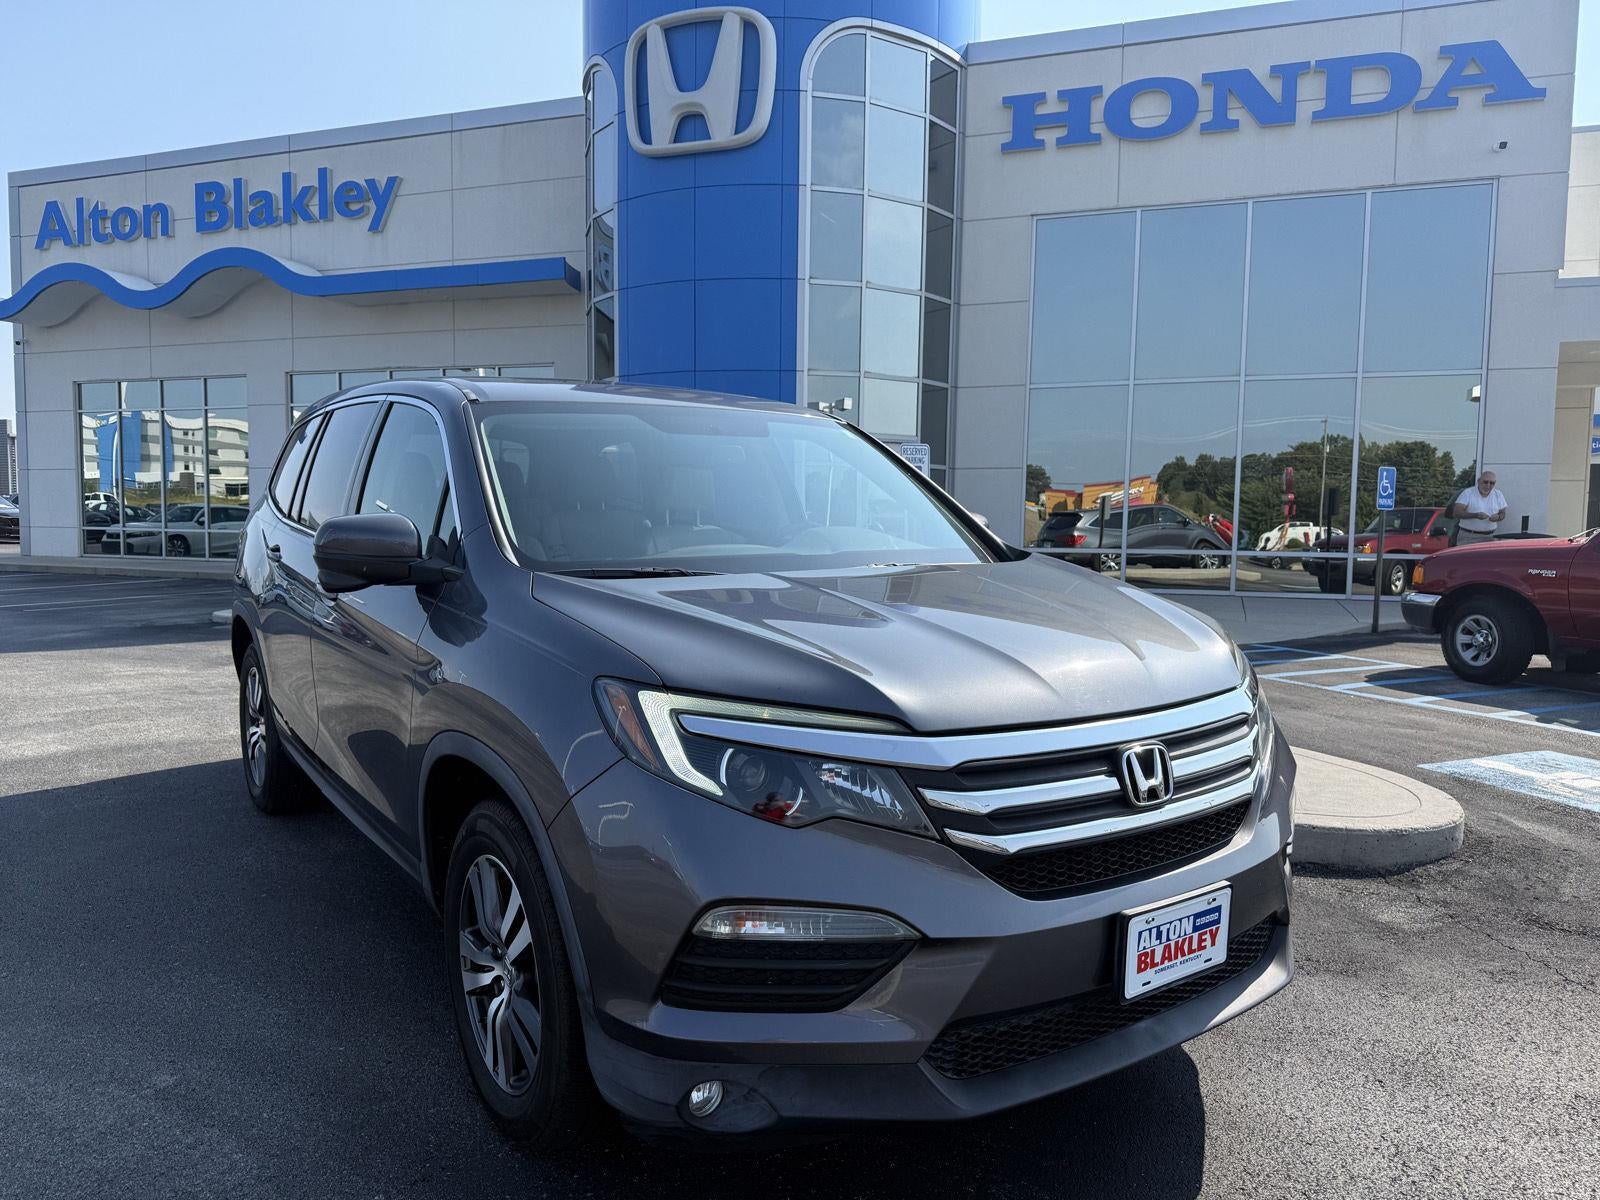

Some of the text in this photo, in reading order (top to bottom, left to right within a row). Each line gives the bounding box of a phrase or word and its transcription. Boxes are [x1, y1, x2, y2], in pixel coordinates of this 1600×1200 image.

[1001, 40, 1546, 153] HONDA
[35, 167, 402, 250] Alton Blakley
[902, 447, 927, 456] RESERVED
[1136, 926, 1221, 975] BLAKLEY
[1138, 915, 1194, 951] ALTON
[1179, 953, 1203, 965] KENTUCKY
